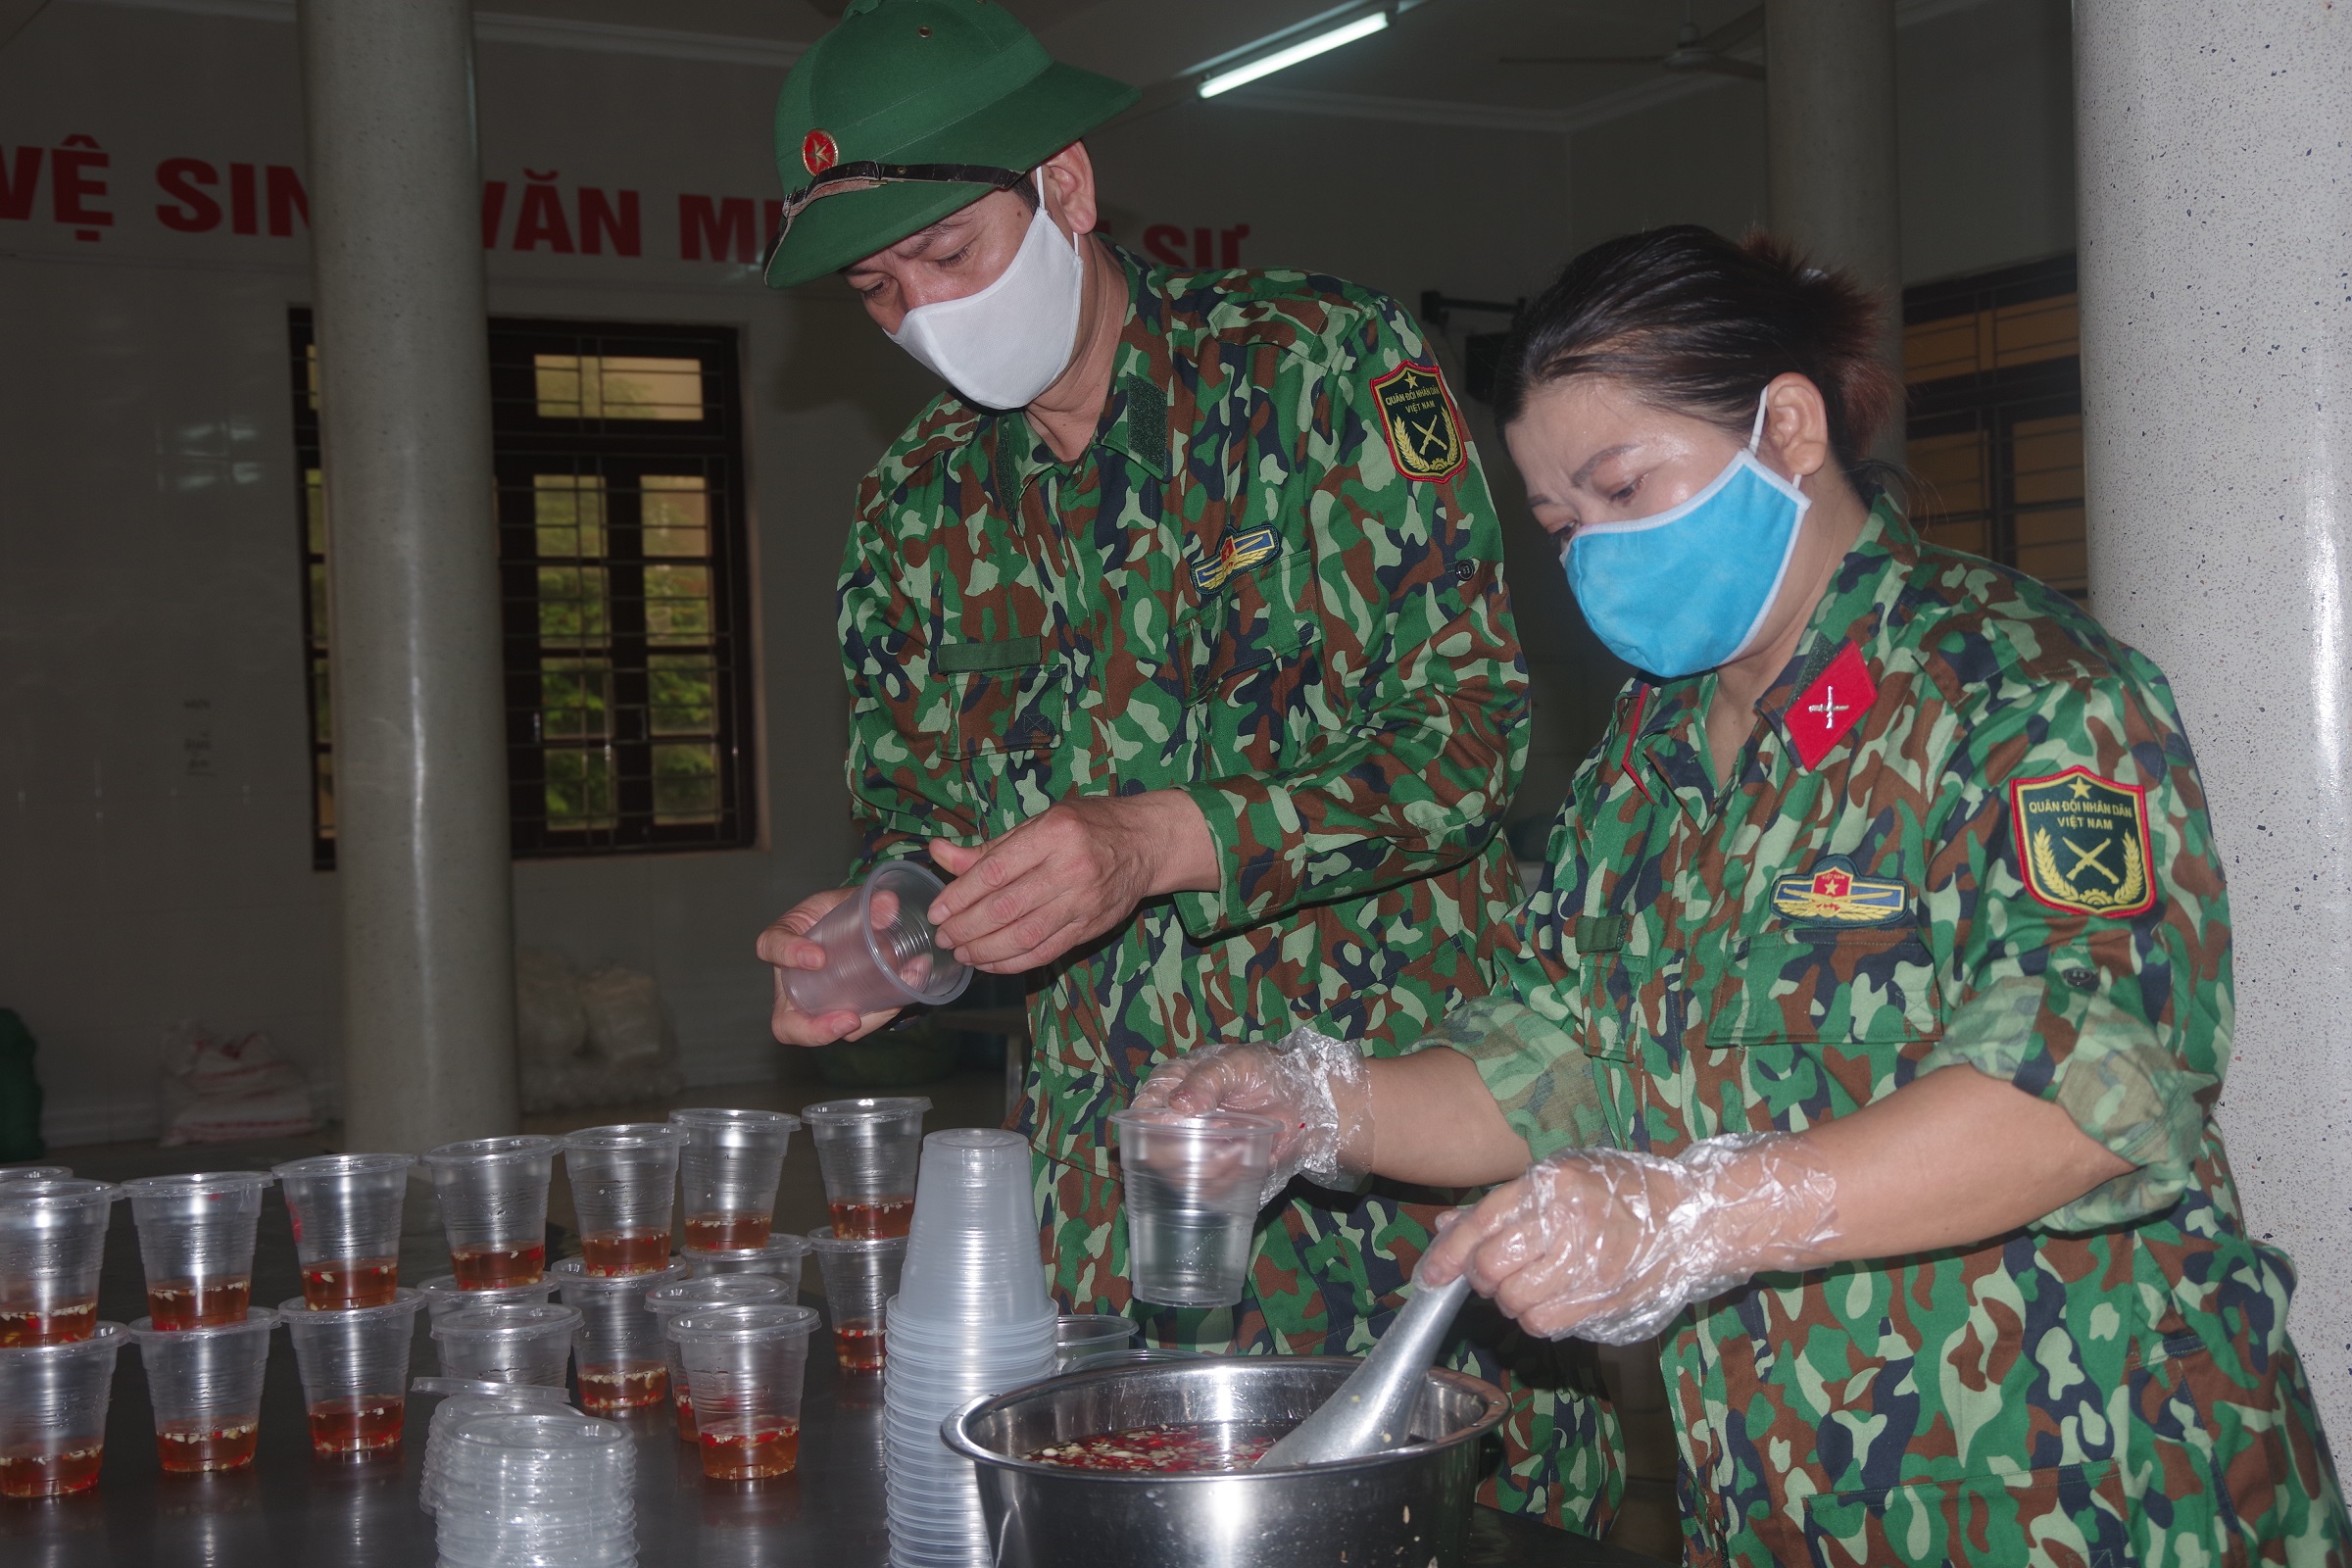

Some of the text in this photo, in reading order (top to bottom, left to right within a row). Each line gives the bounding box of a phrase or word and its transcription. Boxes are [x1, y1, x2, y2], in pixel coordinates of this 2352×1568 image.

[0, 133, 114, 241] VỆ
[155, 157, 311, 237] SIN
[1385, 392, 1406, 406] QUÂN
[1404, 389, 1417, 402] ĐỘI
[1415, 385, 1432, 399] NHÂN
[1404, 400, 1436, 414] VIỆT NAM
[2029, 798, 2132, 818] QUÂN ĐỘI NHÂN DÂN
[2057, 813, 2113, 830] VIỆT NAM
